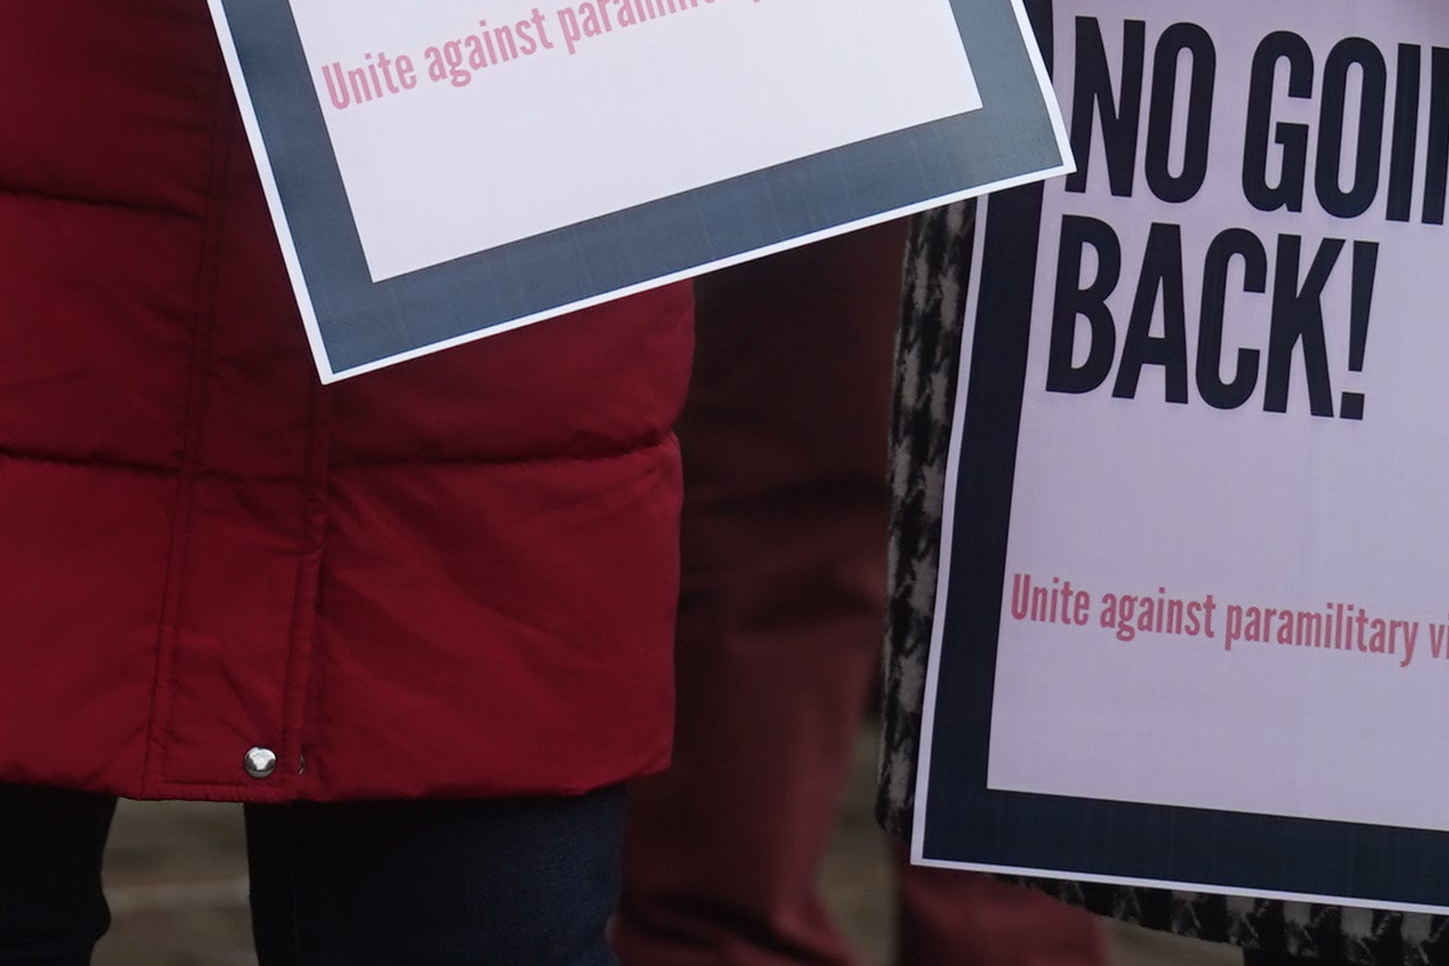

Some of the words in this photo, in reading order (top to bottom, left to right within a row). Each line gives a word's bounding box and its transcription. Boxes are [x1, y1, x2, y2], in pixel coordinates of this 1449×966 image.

[322, 52, 417, 110] Unite
[424, 7, 554, 88] against
[1064, 15, 1217, 204] NO
[1045, 214, 1380, 421] BACK!
[1011, 573, 1090, 626] Unite
[1100, 587, 1216, 642] against
[1225, 602, 1420, 668] paramilitary
